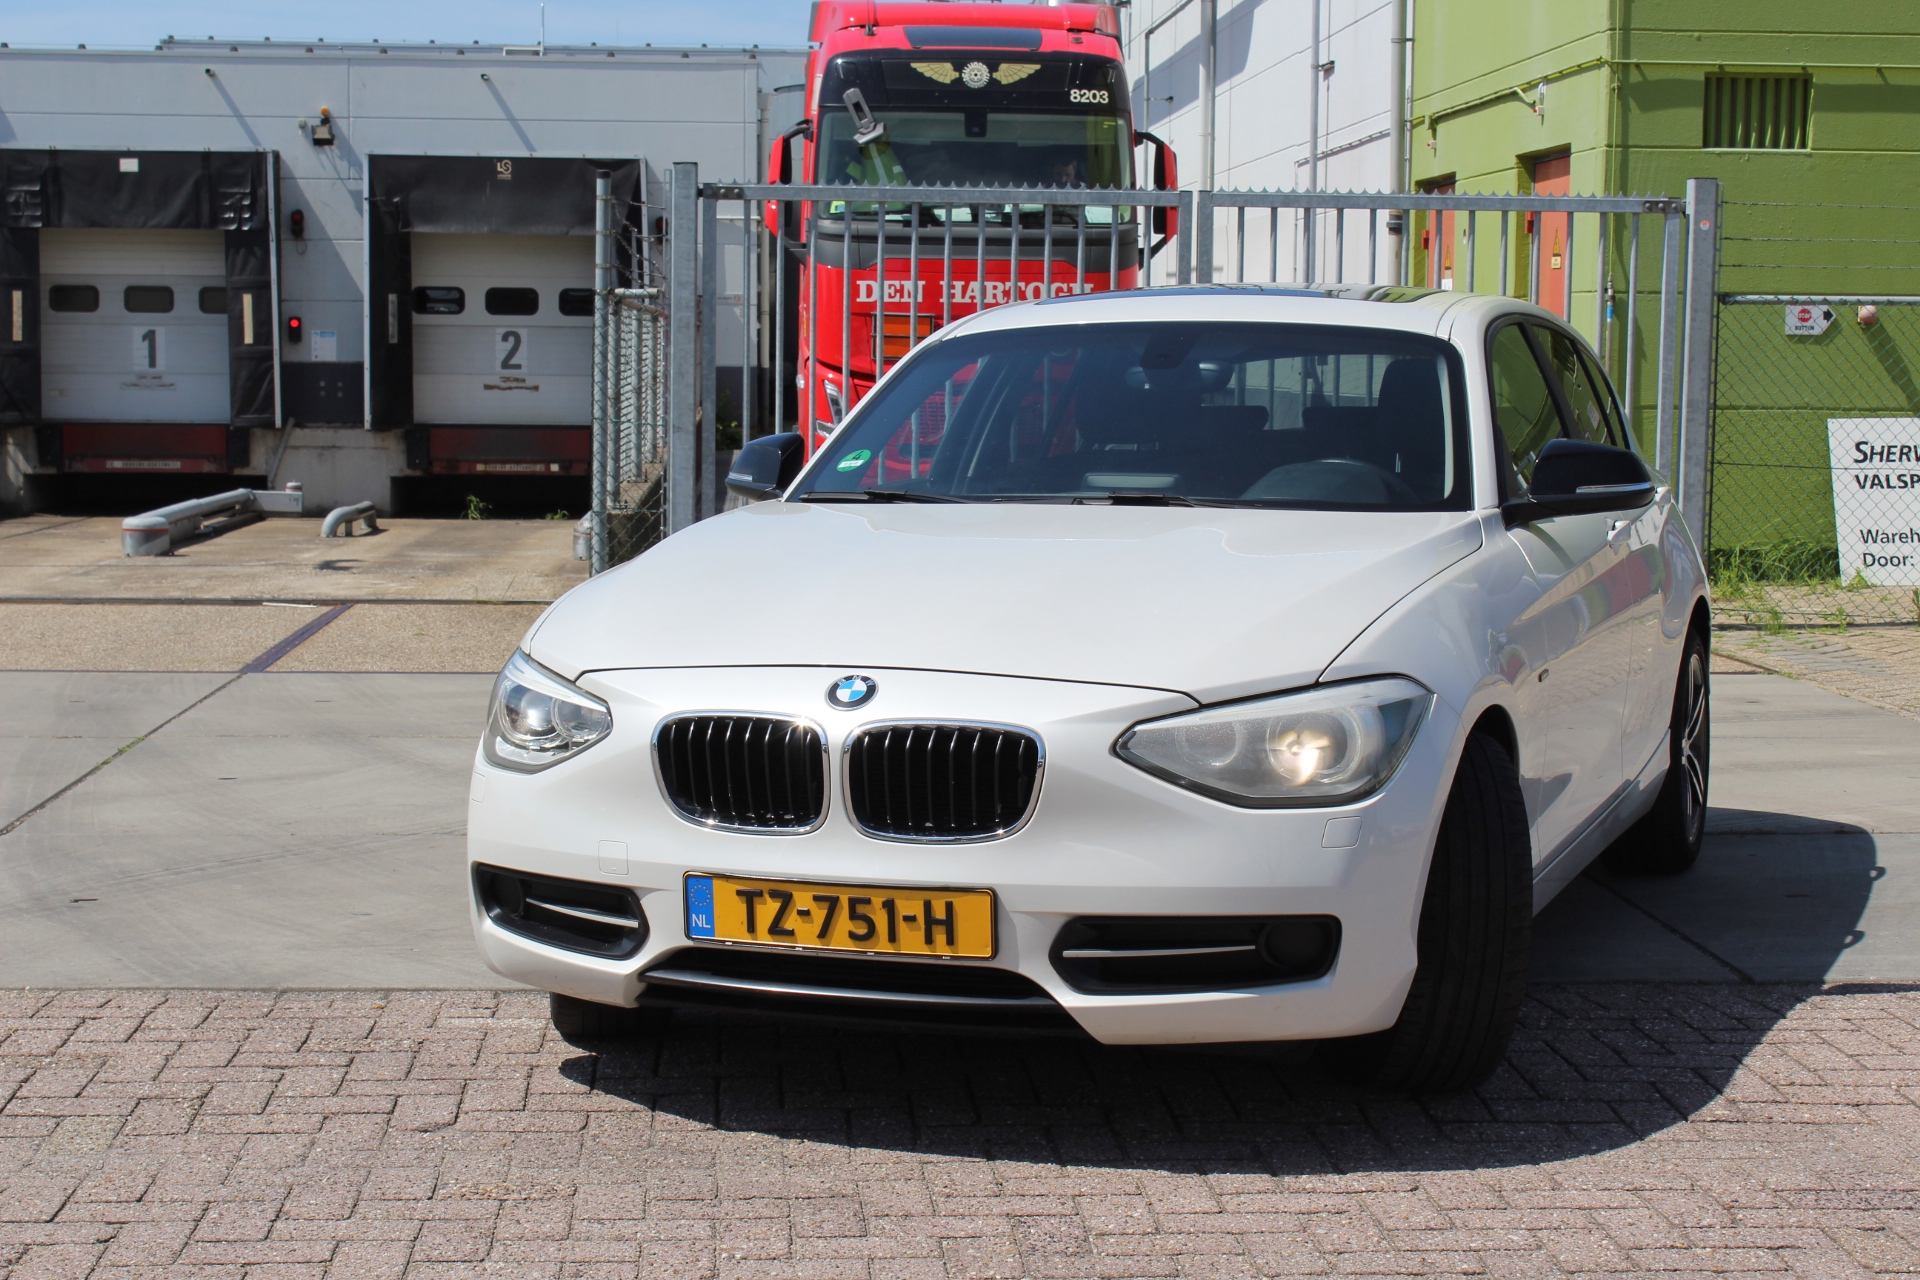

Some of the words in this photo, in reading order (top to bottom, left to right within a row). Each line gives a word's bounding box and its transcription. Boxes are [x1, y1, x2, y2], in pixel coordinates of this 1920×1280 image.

[1070, 88, 1109, 104] 8203
[856, 280, 926, 303] DEN
[142, 329, 157, 369] 1
[501, 330, 522, 370] 2
[1854, 473, 1920, 490] VALSP
[1862, 552, 1915, 568] Door:
[692, 913, 711, 929] NL
[735, 887, 955, 947] TZ-751-H
